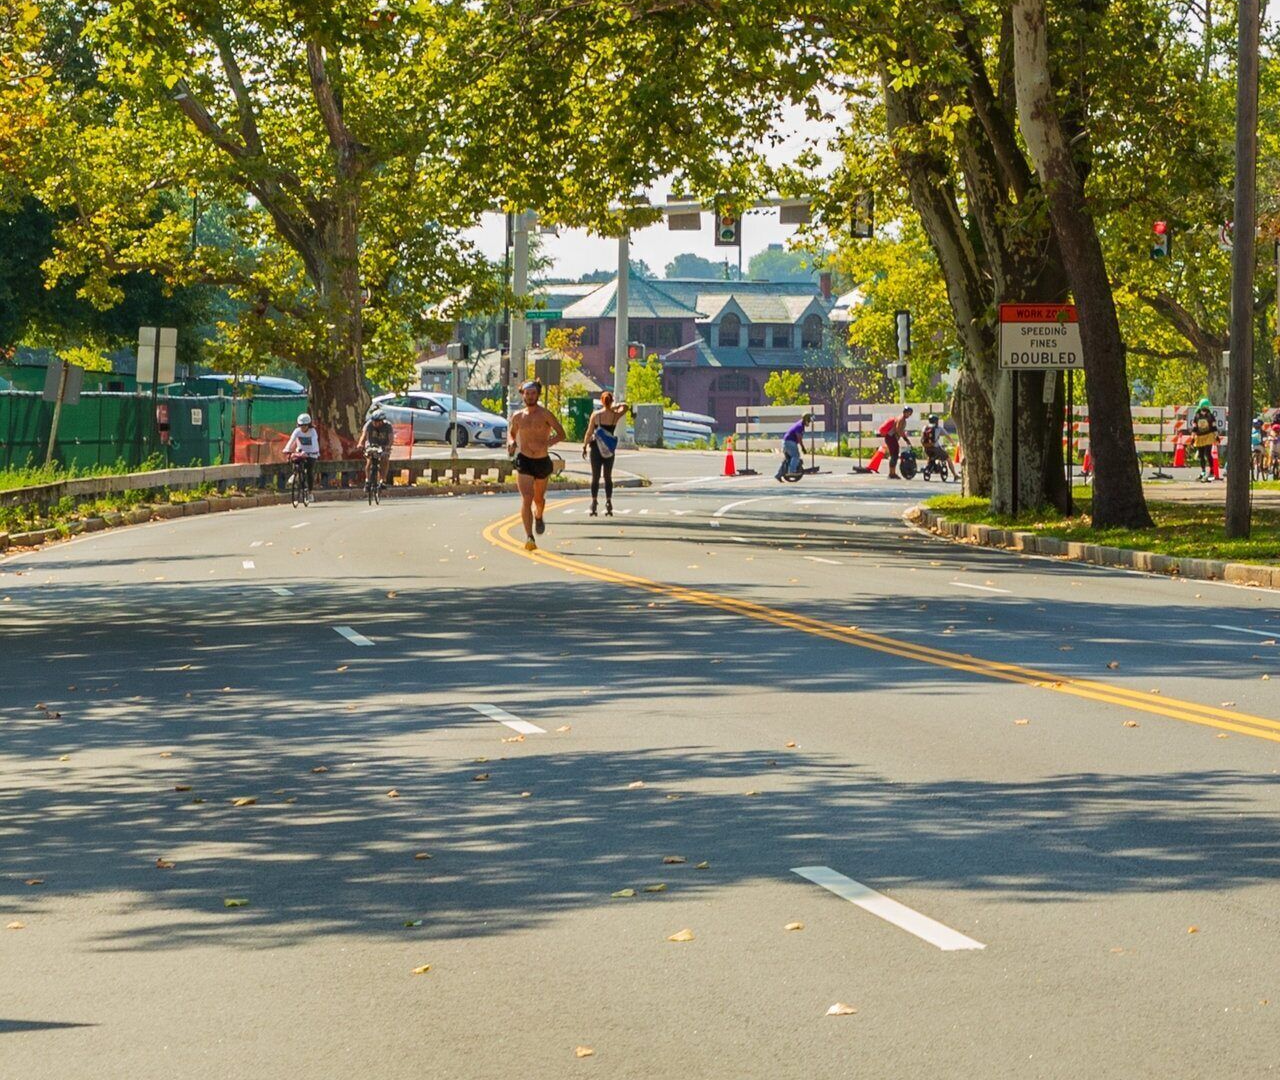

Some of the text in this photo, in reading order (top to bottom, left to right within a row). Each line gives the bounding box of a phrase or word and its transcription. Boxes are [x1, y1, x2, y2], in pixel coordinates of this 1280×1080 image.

[1016, 309, 1042, 319] WORK
[1021, 327, 1067, 336] SPEEDING
[1030, 339, 1057, 348] FINES
[1011, 352, 1076, 364] DOUBLED
